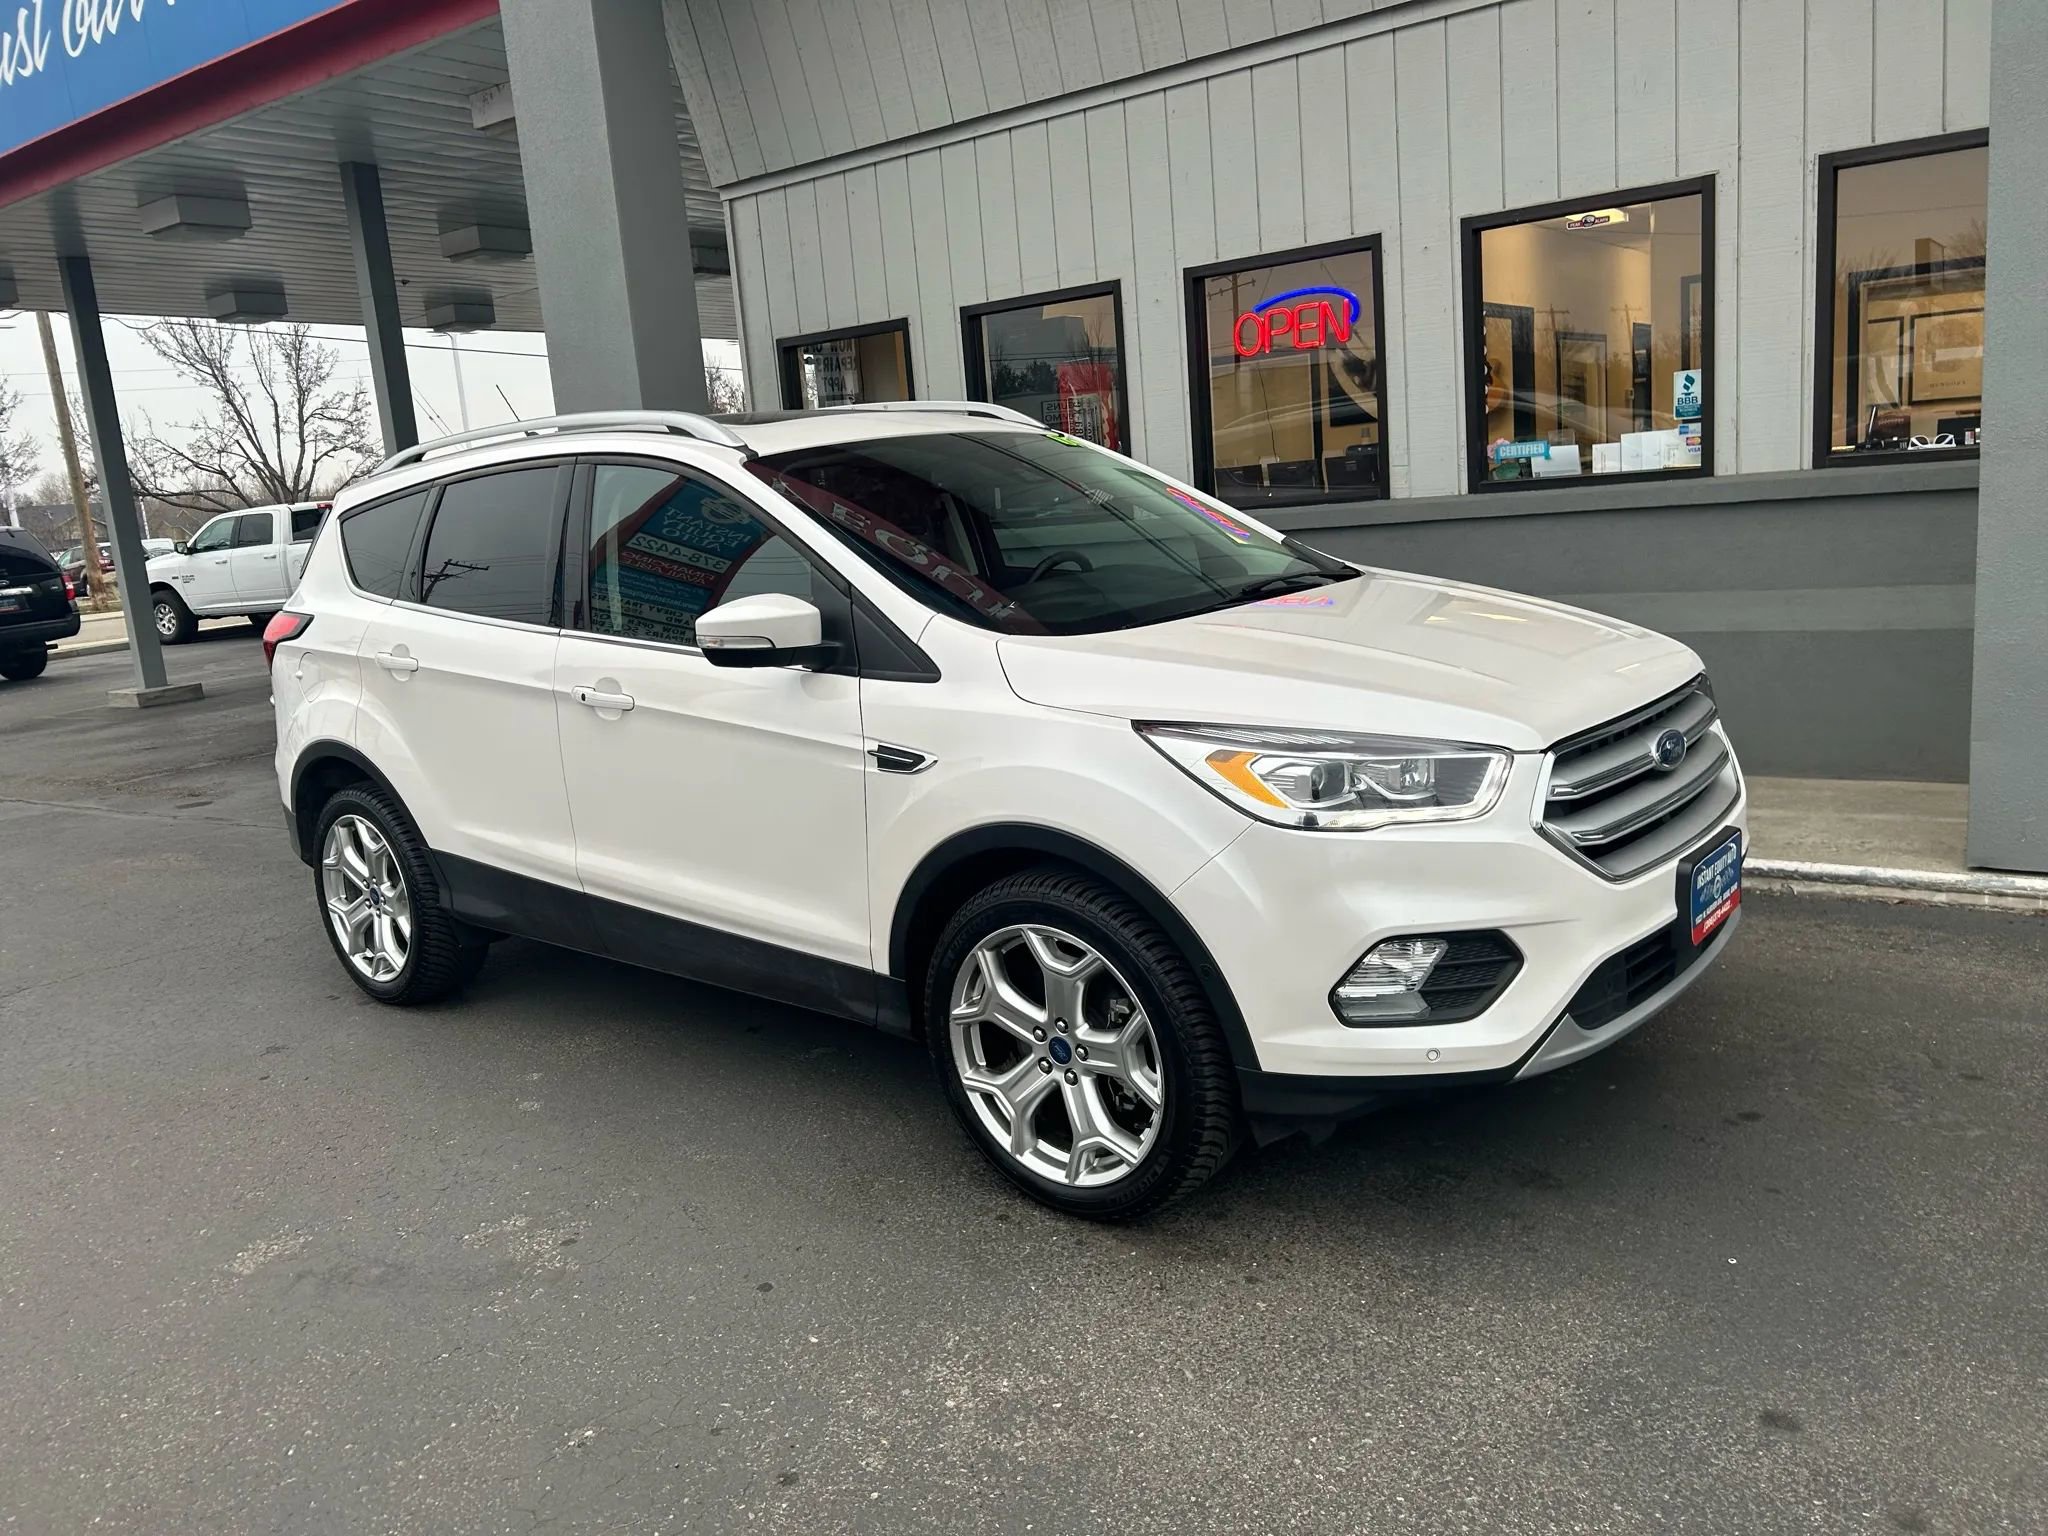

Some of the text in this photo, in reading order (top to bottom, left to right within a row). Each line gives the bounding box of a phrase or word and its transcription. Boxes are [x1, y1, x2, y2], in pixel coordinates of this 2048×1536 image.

[1233, 298, 1352, 356] OPEN
[1677, 396, 1699, 406] BBB
[1500, 443, 1545, 457] CERTIFIED
